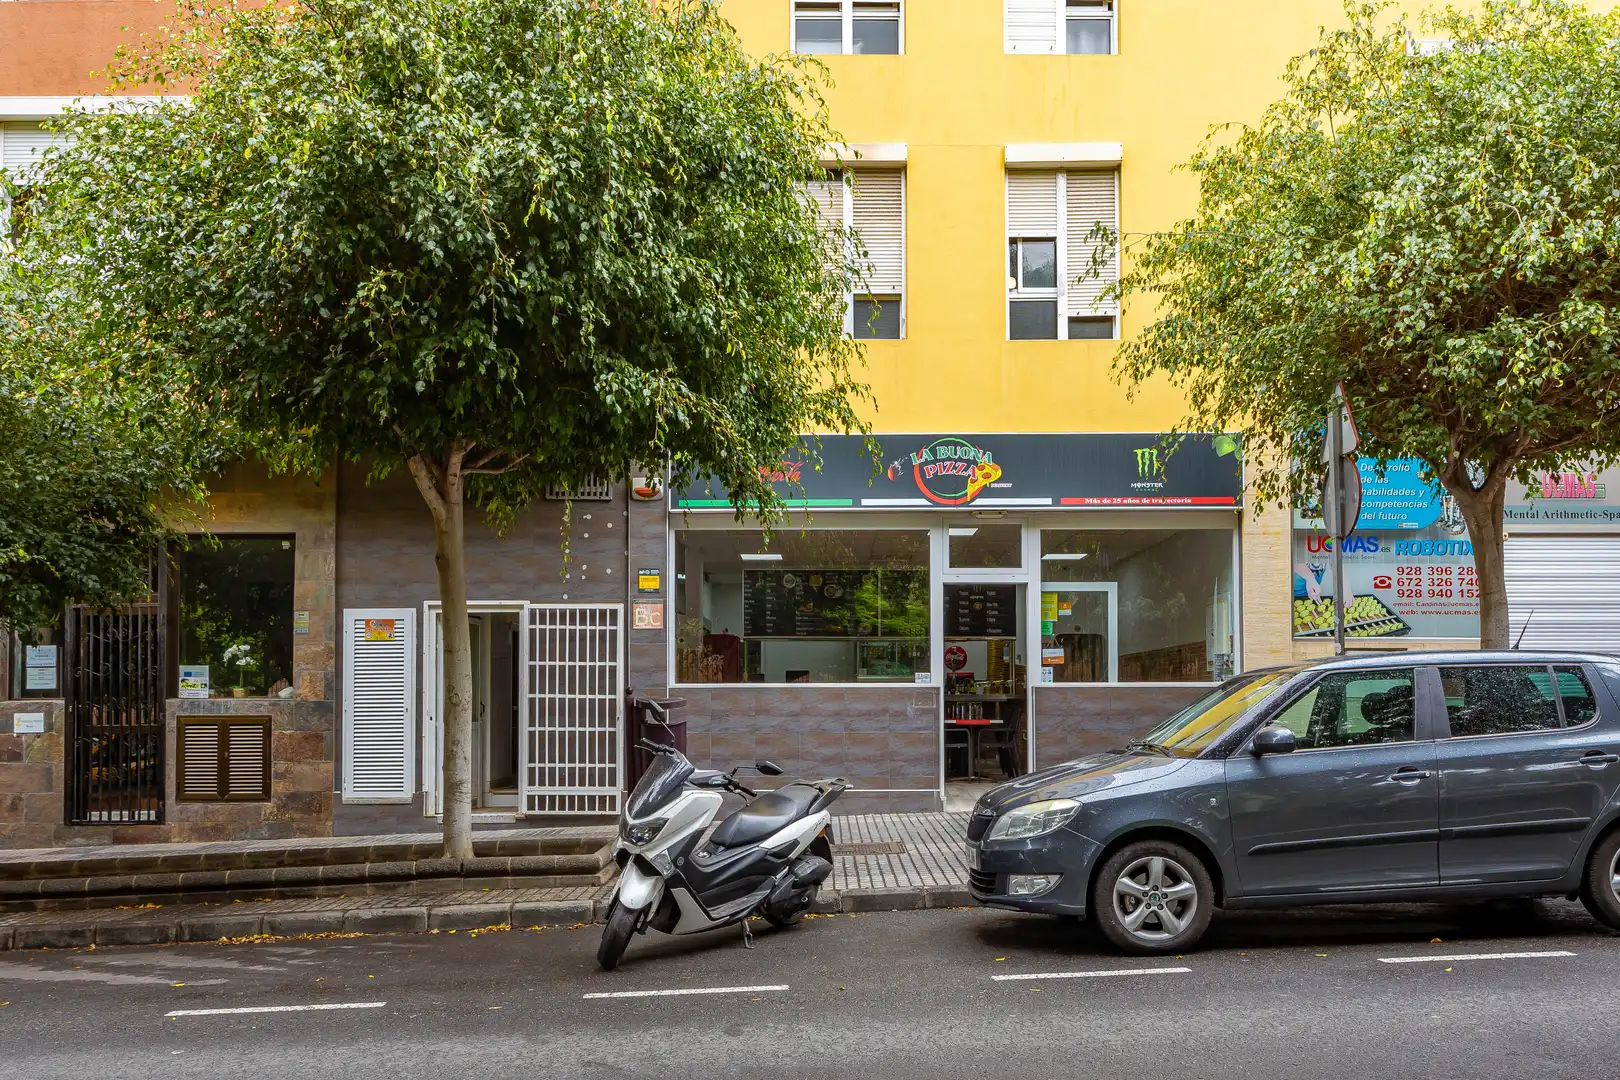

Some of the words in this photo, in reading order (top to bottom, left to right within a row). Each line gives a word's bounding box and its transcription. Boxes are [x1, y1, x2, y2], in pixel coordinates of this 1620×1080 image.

[910, 448, 934, 465] LA
[936, 445, 993, 465] BUONA
[924, 461, 979, 479] PIZZA
[1360, 475, 1372, 484] de
[1542, 472, 1597, 498] UCMAS
[1361, 487, 1416, 496] habilidades
[1419, 489, 1425, 498] y
[1151, 497, 1192, 505] trayectoria
[1360, 500, 1428, 510] competencias
[1361, 511, 1376, 520] del
[1378, 511, 1408, 520] futuro
[1503, 509, 1539, 519] Mental
[1396, 566, 1422, 576] 928
[1427, 566, 1453, 576] 396
[1396, 577, 1422, 587] 672
[1427, 577, 1453, 587] 326
[1396, 588, 1422, 598] 928
[1427, 588, 1453, 598] 940
